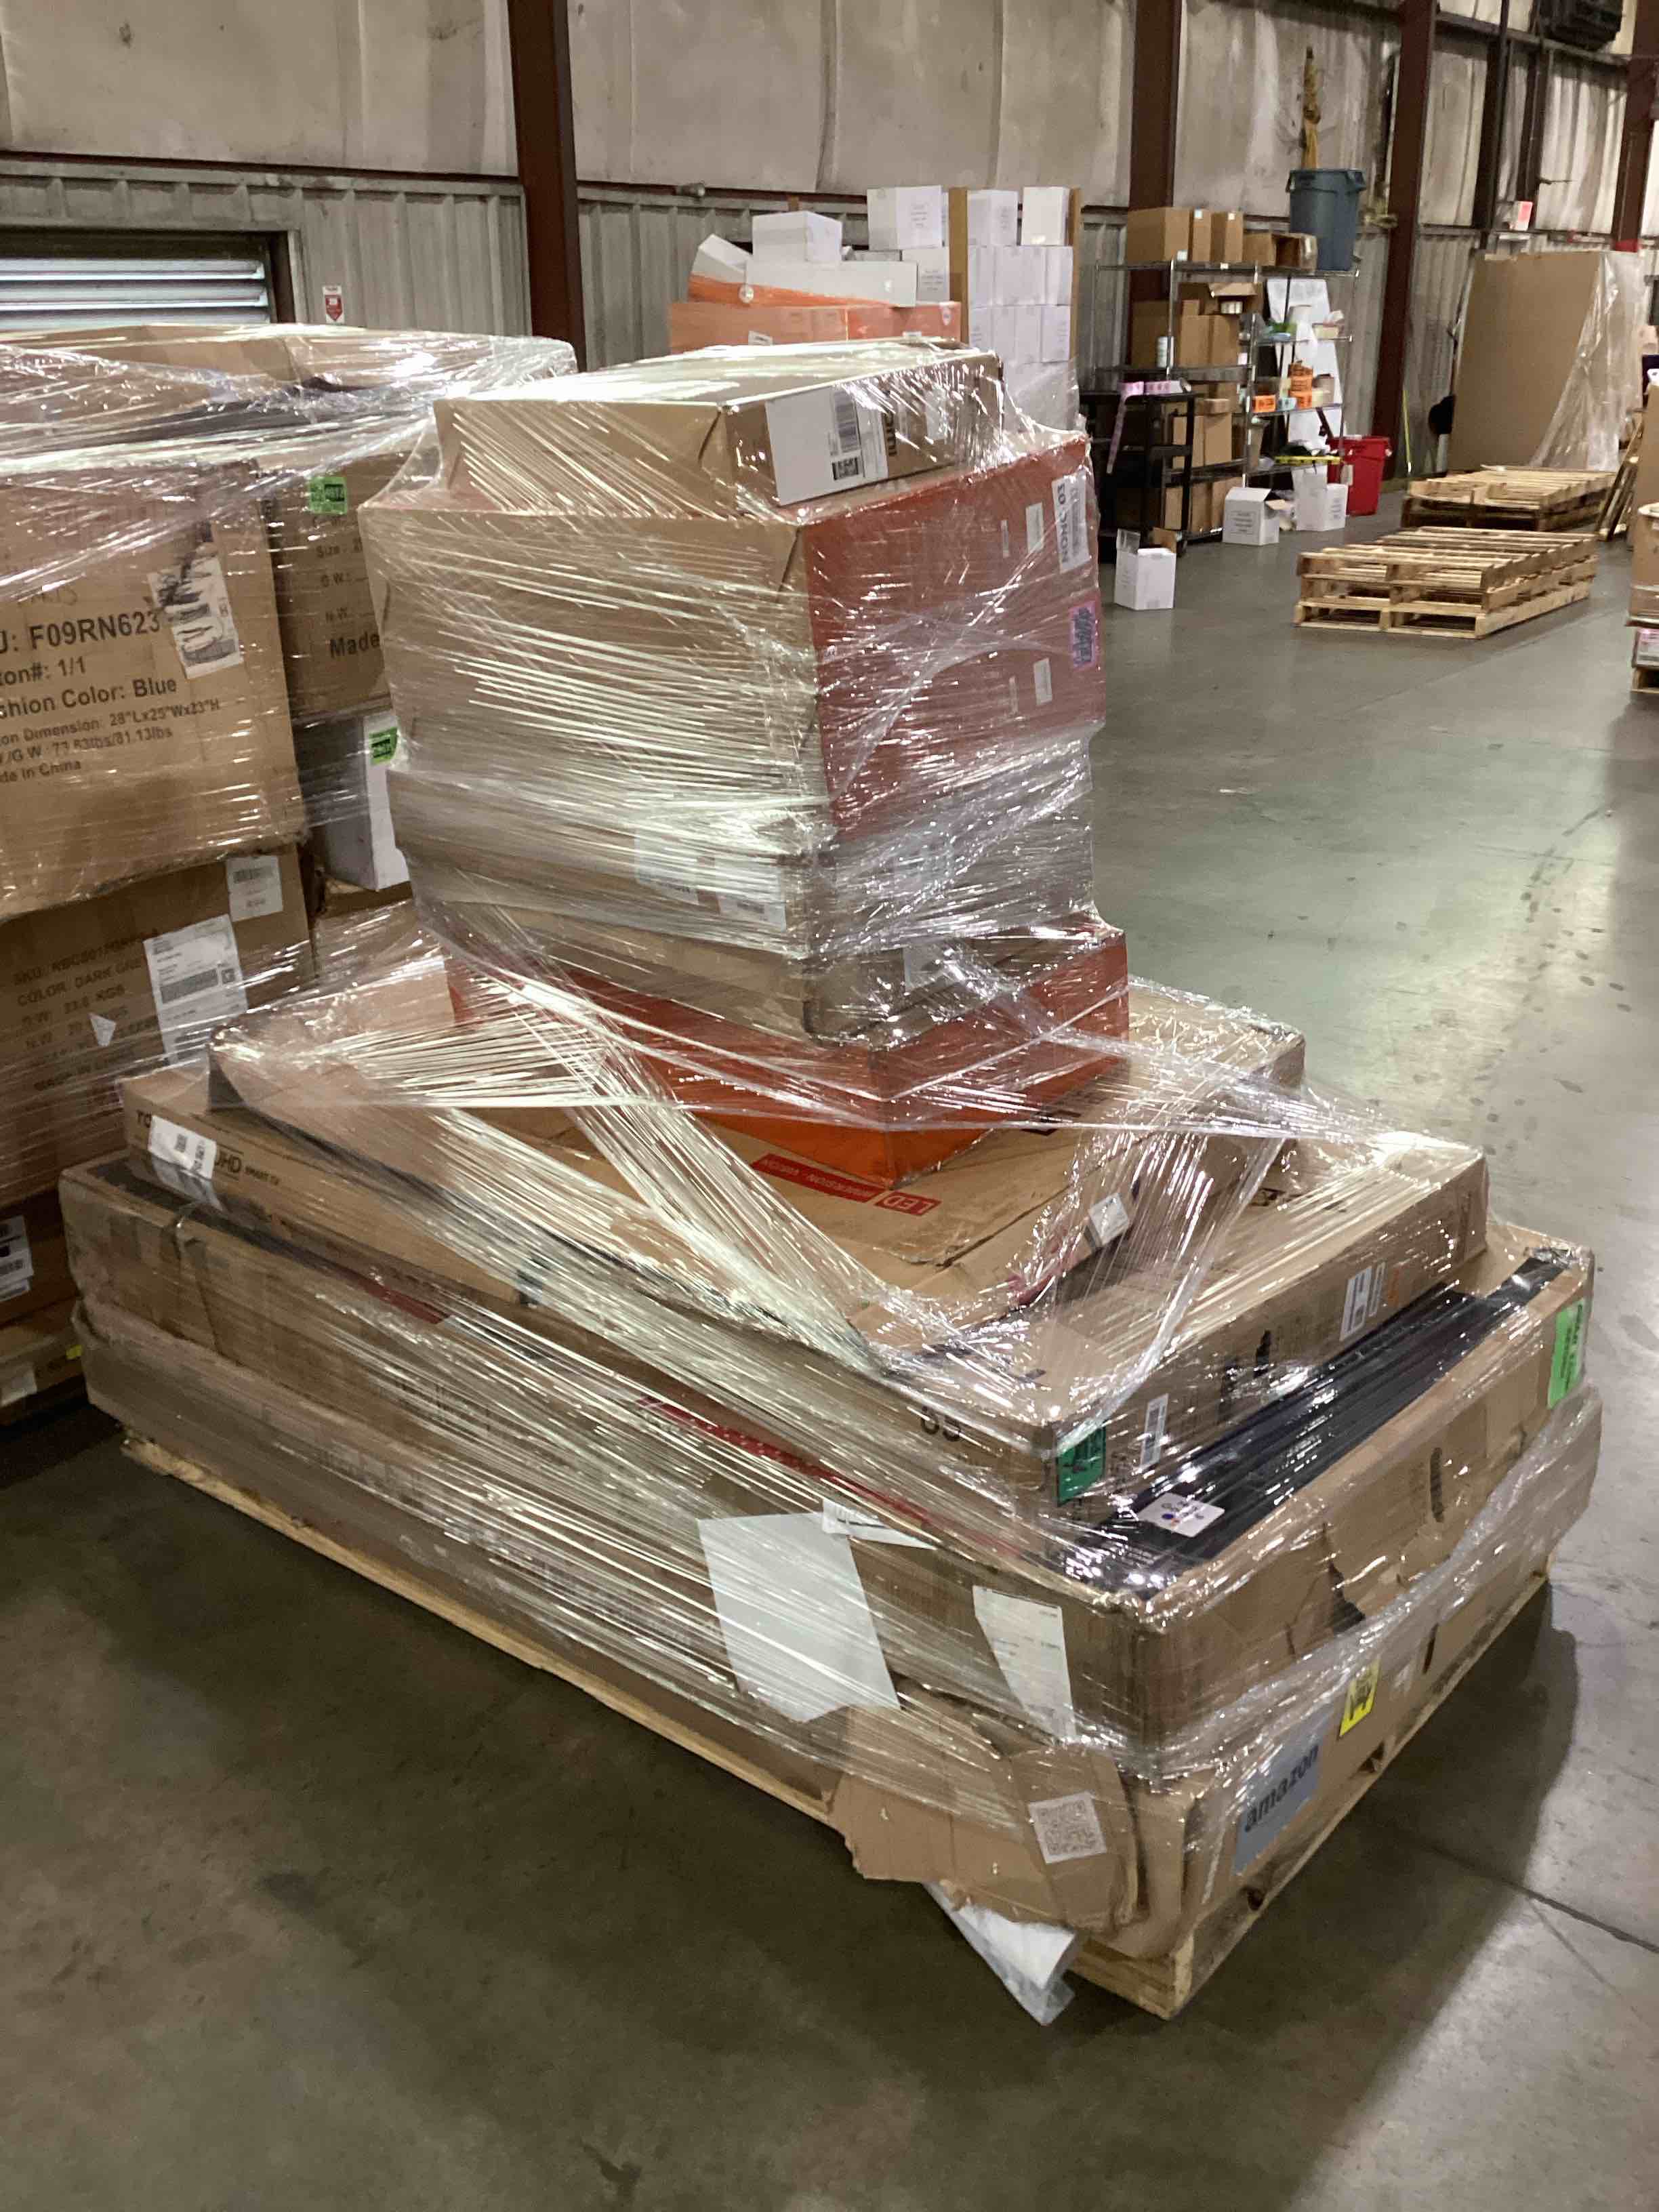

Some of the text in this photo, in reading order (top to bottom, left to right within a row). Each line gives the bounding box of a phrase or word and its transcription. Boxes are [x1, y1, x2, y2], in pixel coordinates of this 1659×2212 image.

[58, 655, 85, 676] 1/1
[62, 686, 125, 708] Color:
[133, 678, 177, 697] Blue
[882, 1195, 935, 1214] LED
[1245, 1744, 1319, 1832] amazon
